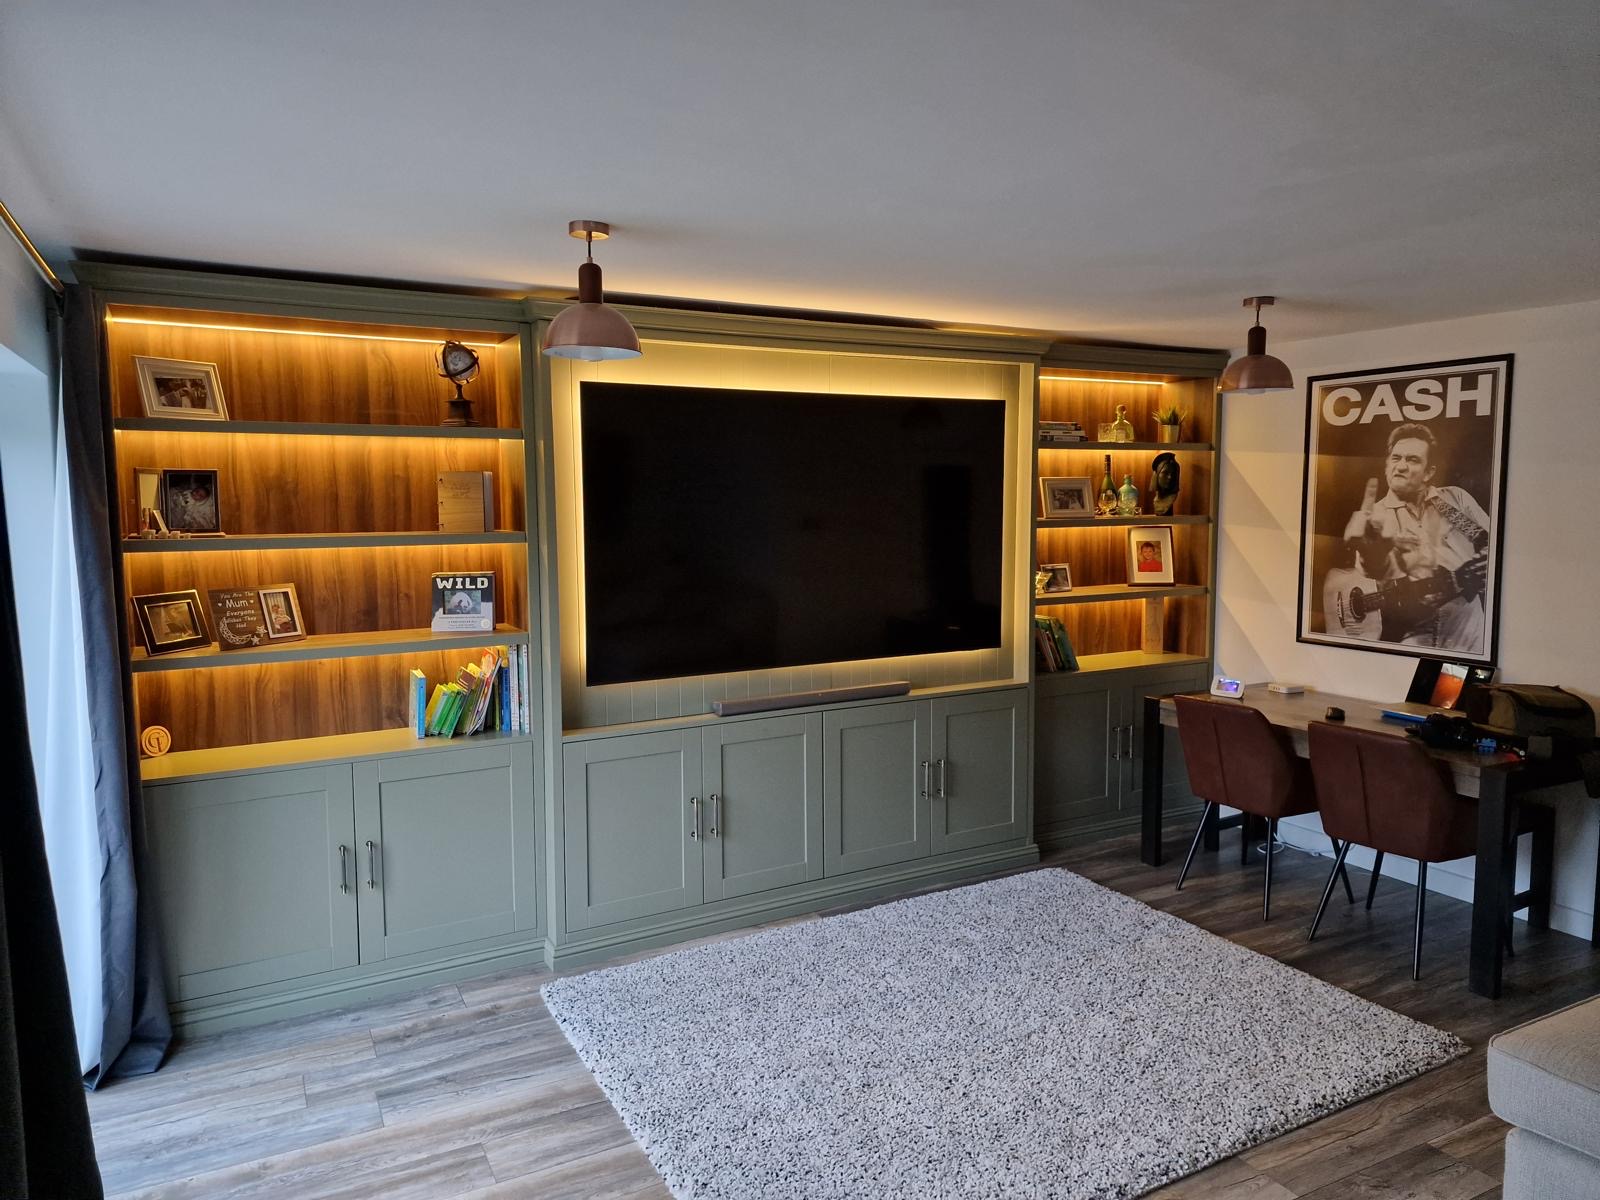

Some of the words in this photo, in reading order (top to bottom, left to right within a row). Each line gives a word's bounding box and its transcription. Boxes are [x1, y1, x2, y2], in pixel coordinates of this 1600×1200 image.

[1323, 374, 1493, 426] CASH
[436, 577, 489, 589] WILD
[226, 599, 249, 608] Mum
[226, 609, 255, 617] Everyone
